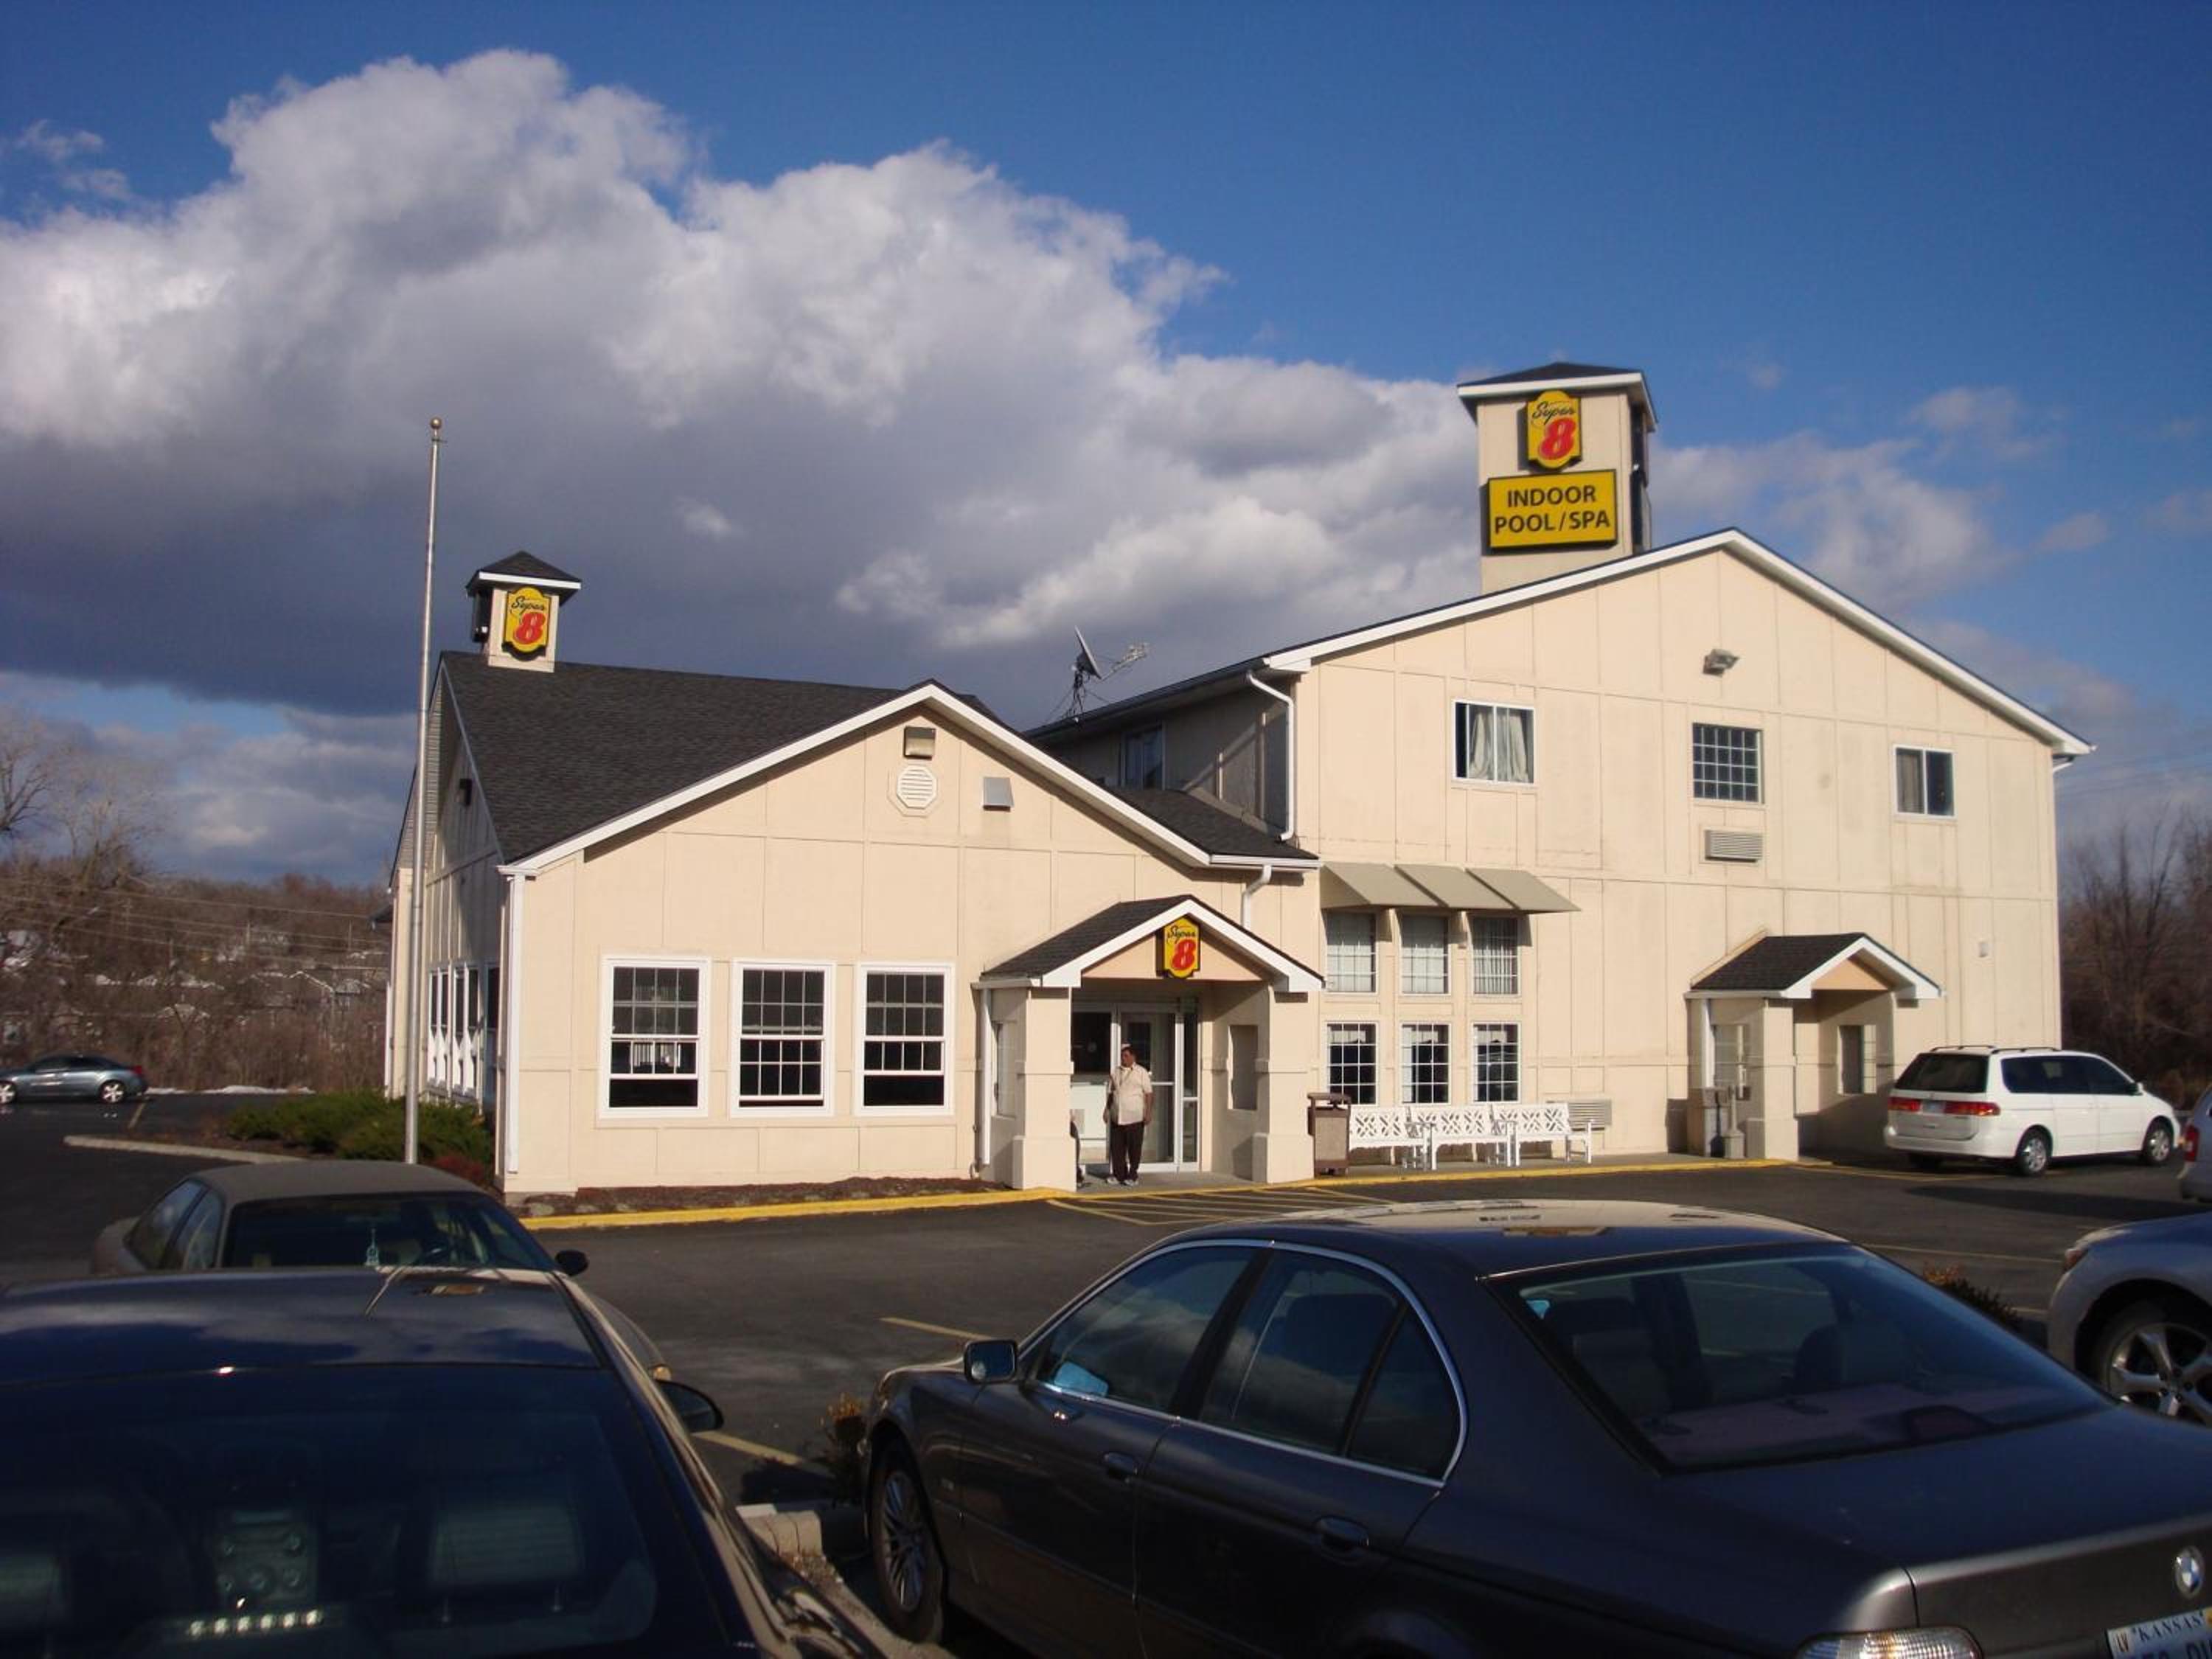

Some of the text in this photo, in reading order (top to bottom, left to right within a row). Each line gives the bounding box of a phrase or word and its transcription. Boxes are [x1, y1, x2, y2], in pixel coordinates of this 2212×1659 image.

[1532, 401, 1576, 425] Super
[1539, 417, 1576, 460] 8
[1507, 484, 1596, 508] INDOOR
[513, 611, 546, 645] 8
[1171, 939, 1197, 971] 8
[2138, 1615, 2203, 1642] KANSAS
